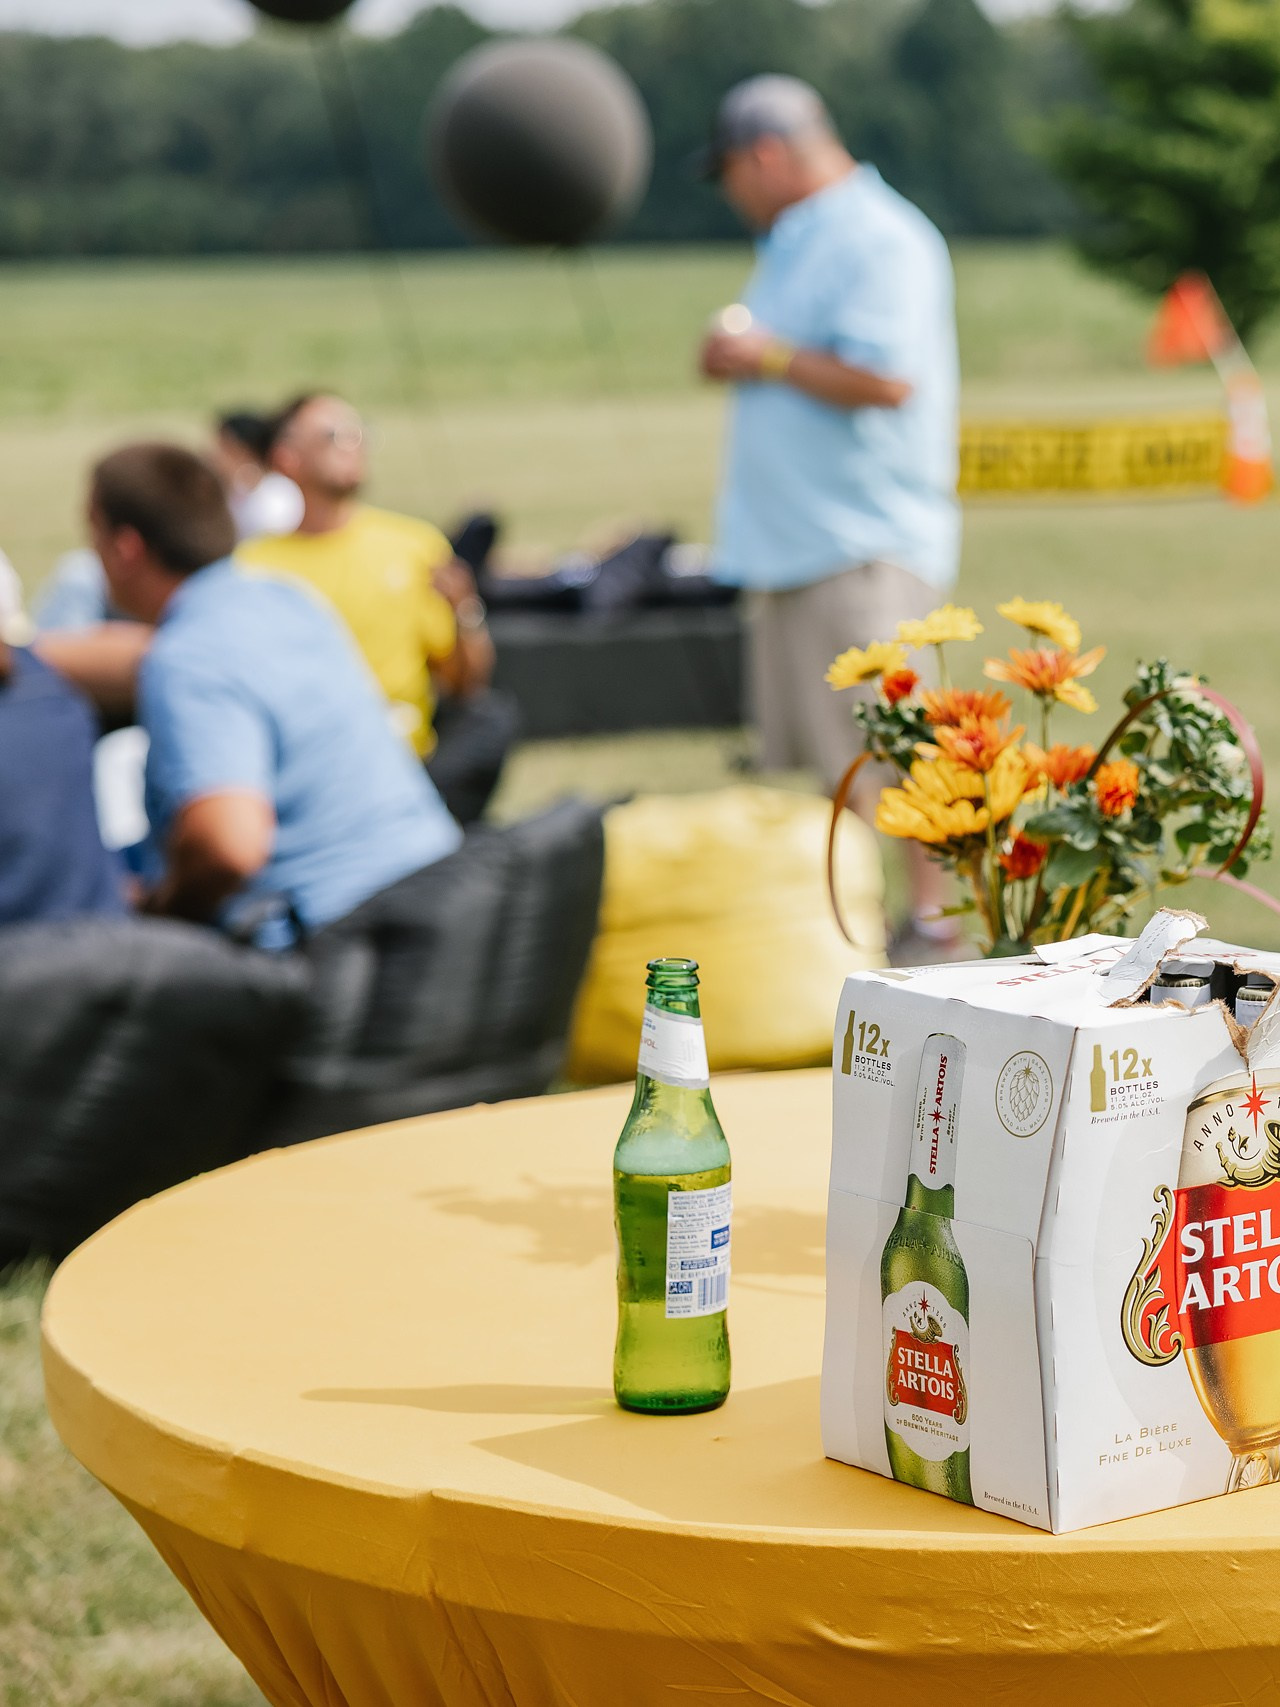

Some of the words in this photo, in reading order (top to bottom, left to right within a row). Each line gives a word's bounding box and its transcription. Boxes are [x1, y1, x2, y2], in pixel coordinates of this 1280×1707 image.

[997, 958, 1116, 986] STELLA
[858, 1020, 891, 1057] 12x
[855, 1055, 892, 1071] BOTTLES
[1013, 1057, 1027, 1066] WITH
[1109, 1048, 1153, 1082] 12x
[1110, 1081, 1159, 1096] BOTTLES
[929, 1126, 940, 1175] STELLA
[935, 1055, 948, 1107] ARTOIS
[1003, 1113, 1014, 1127] AND
[1091, 1113, 1119, 1124] Brewed
[1120, 1112, 1128, 1120] in
[1129, 1110, 1140, 1119] the
[1192, 1103, 1235, 1152] ANNO
[897, 1346, 954, 1379] STELLA
[897, 1368, 955, 1401] ARTOIS
[903, 1419, 929, 1433] BREWING
[930, 1427, 959, 1442] HERITAGE
[911, 1413, 923, 1423] 600
[924, 1417, 943, 1429] YEARS
[1115, 1433, 1133, 1444] LA
[1140, 1423, 1178, 1439] BIÈRE
[1099, 1452, 1129, 1466] FINE
[1135, 1446, 1152, 1458] DE
[1159, 1437, 1192, 1452] LUXE
[984, 1491, 1005, 1505] Brewed
[1005, 1499, 1012, 1507] in
[1012, 1501, 1021, 1509] the
